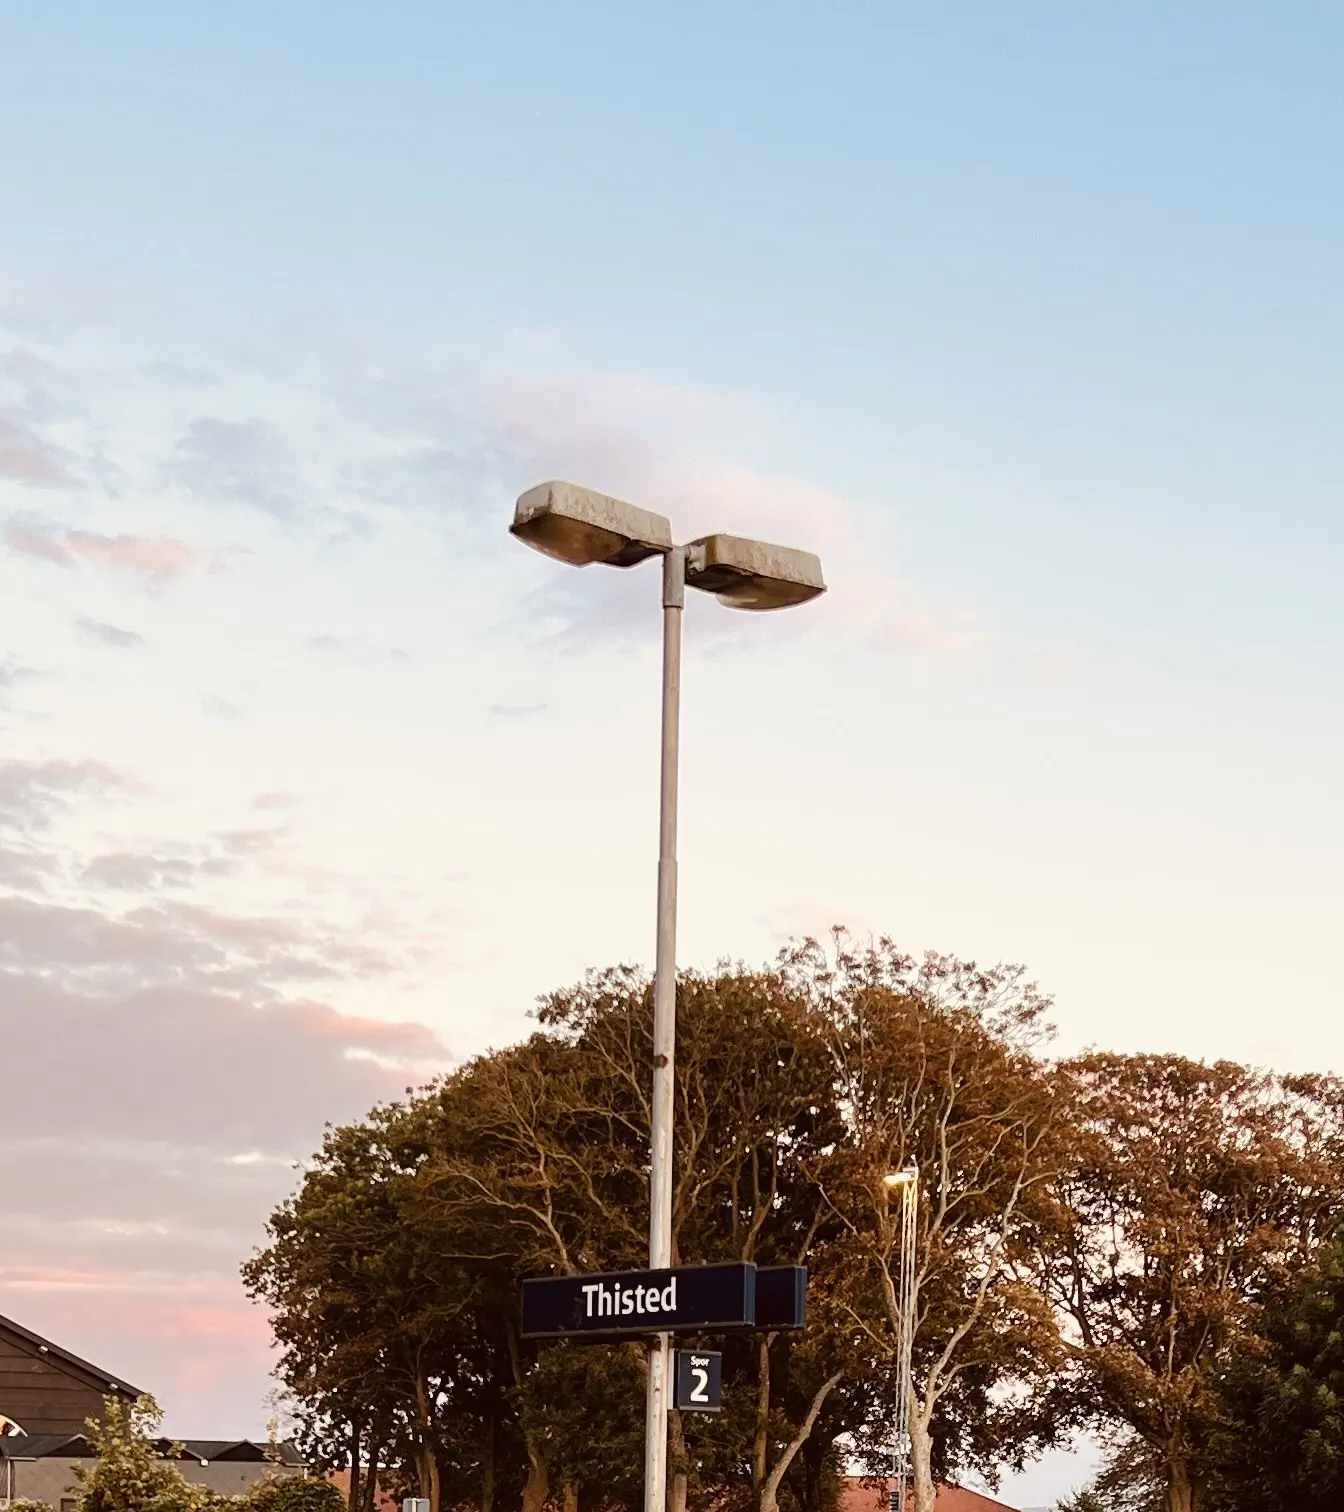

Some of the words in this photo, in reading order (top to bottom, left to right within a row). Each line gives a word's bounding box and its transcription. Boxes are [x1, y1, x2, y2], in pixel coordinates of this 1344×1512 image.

[582, 1276, 677, 1317] Thisted
[690, 1355, 710, 1367] Spor
[690, 1368, 709, 1402] 2
